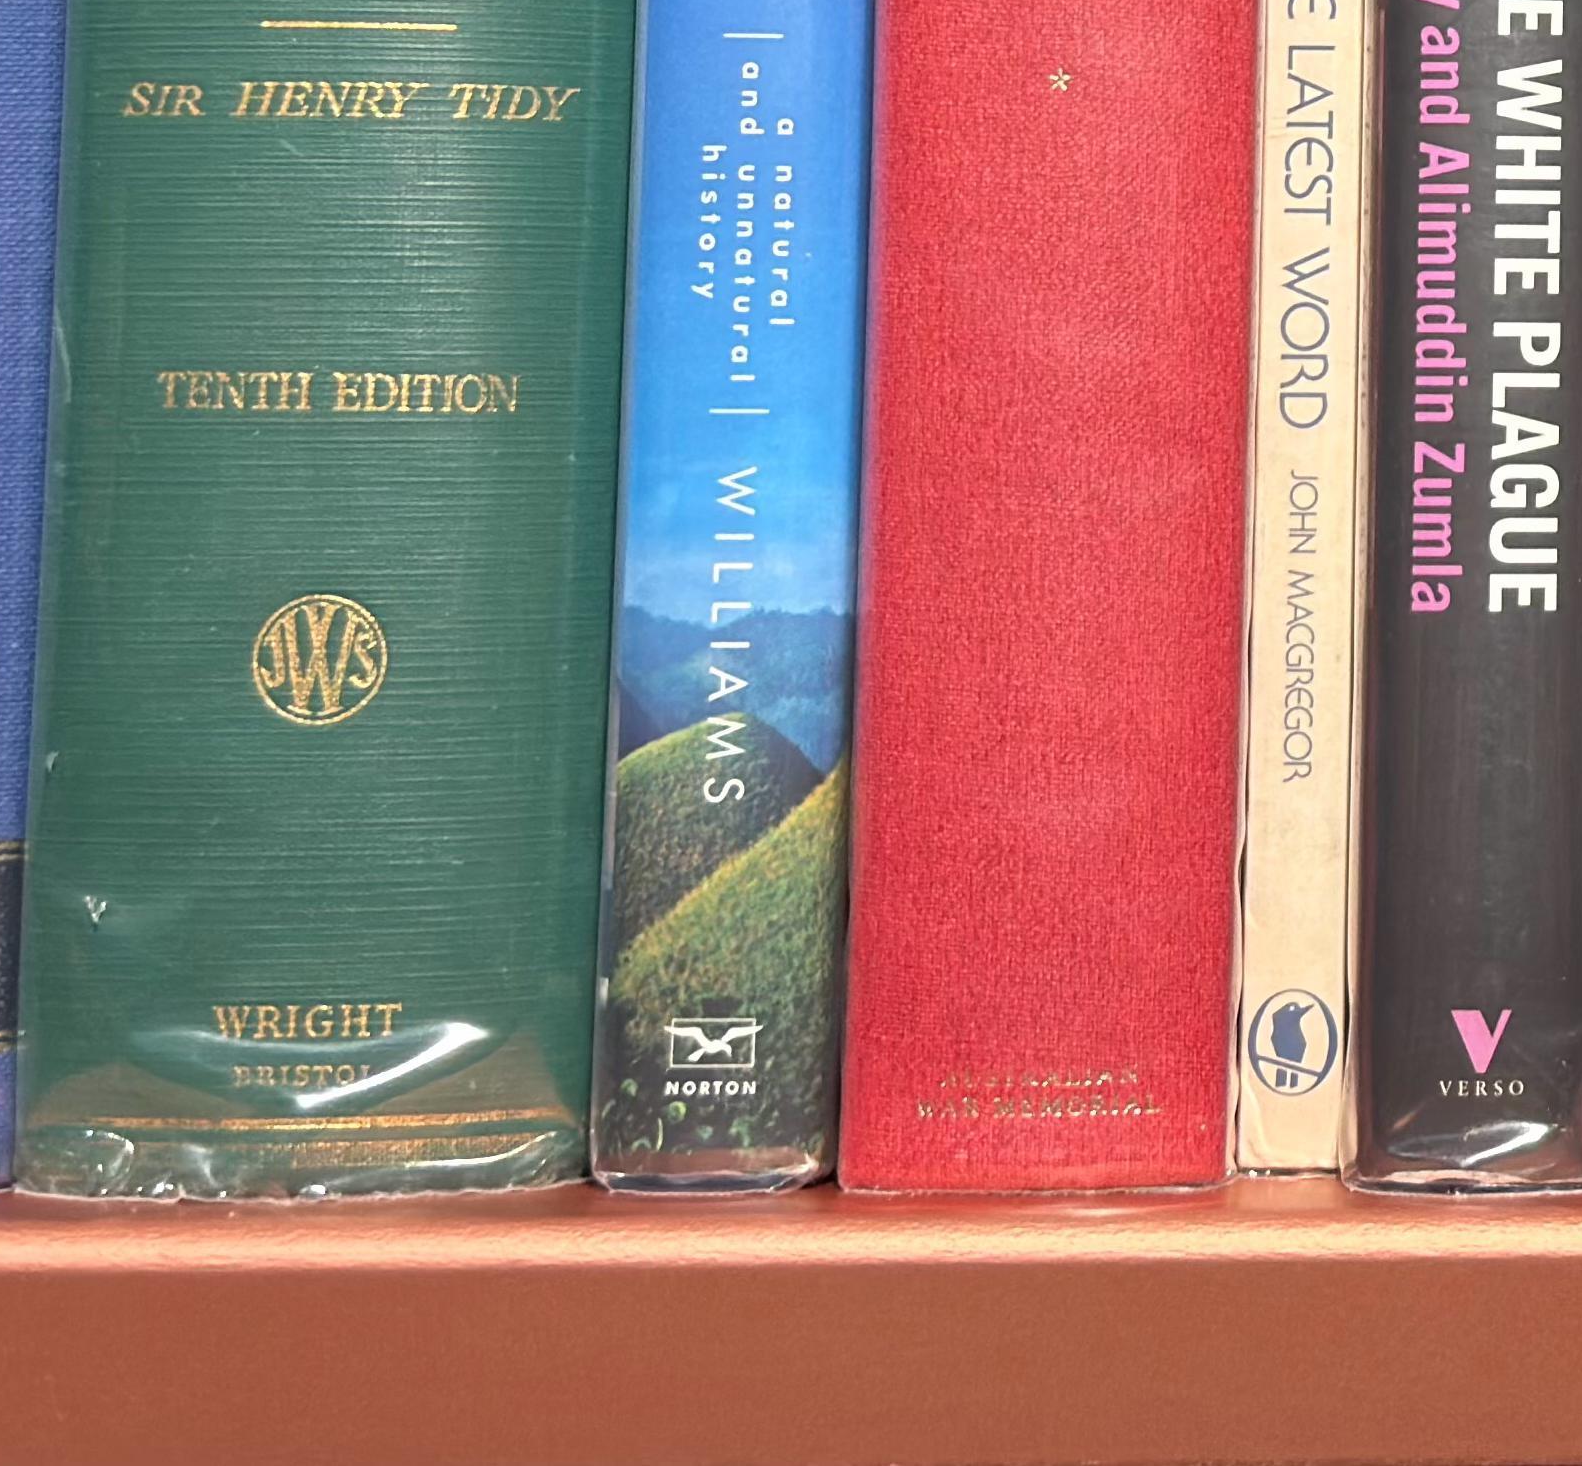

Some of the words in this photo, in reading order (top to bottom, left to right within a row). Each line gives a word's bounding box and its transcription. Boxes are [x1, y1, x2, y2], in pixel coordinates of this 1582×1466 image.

[122, 82, 206, 118] SIR
[231, 82, 429, 119] HENRY
[450, 86, 579, 123] TIDY
[739, 61, 764, 137] and
[1283, 45, 1336, 226] LATEST
[1419, 25, 1470, 125] and
[691, 145, 726, 300] history
[770, 166, 792, 324] natural
[1493, 59, 1563, 296] WHITE
[730, 165, 755, 381] unnatural
[1279, 247, 1331, 429] WORD
[1414, 142, 1471, 423] Alimuddin
[157, 371, 311, 411] TENTH
[332, 372, 519, 415] EDITION
[1487, 322, 1563, 613] PLAGUE
[1287, 469, 1321, 555] JOHN
[1410, 441, 1465, 614] Zumla
[704, 466, 757, 803] WILLIAMS
[1281, 569, 1317, 784] MACGREGOR
[213, 1002, 403, 1039] WRIGHT
[665, 1081, 756, 1095] NORTON
[1438, 1080, 1524, 1097] VERSO
